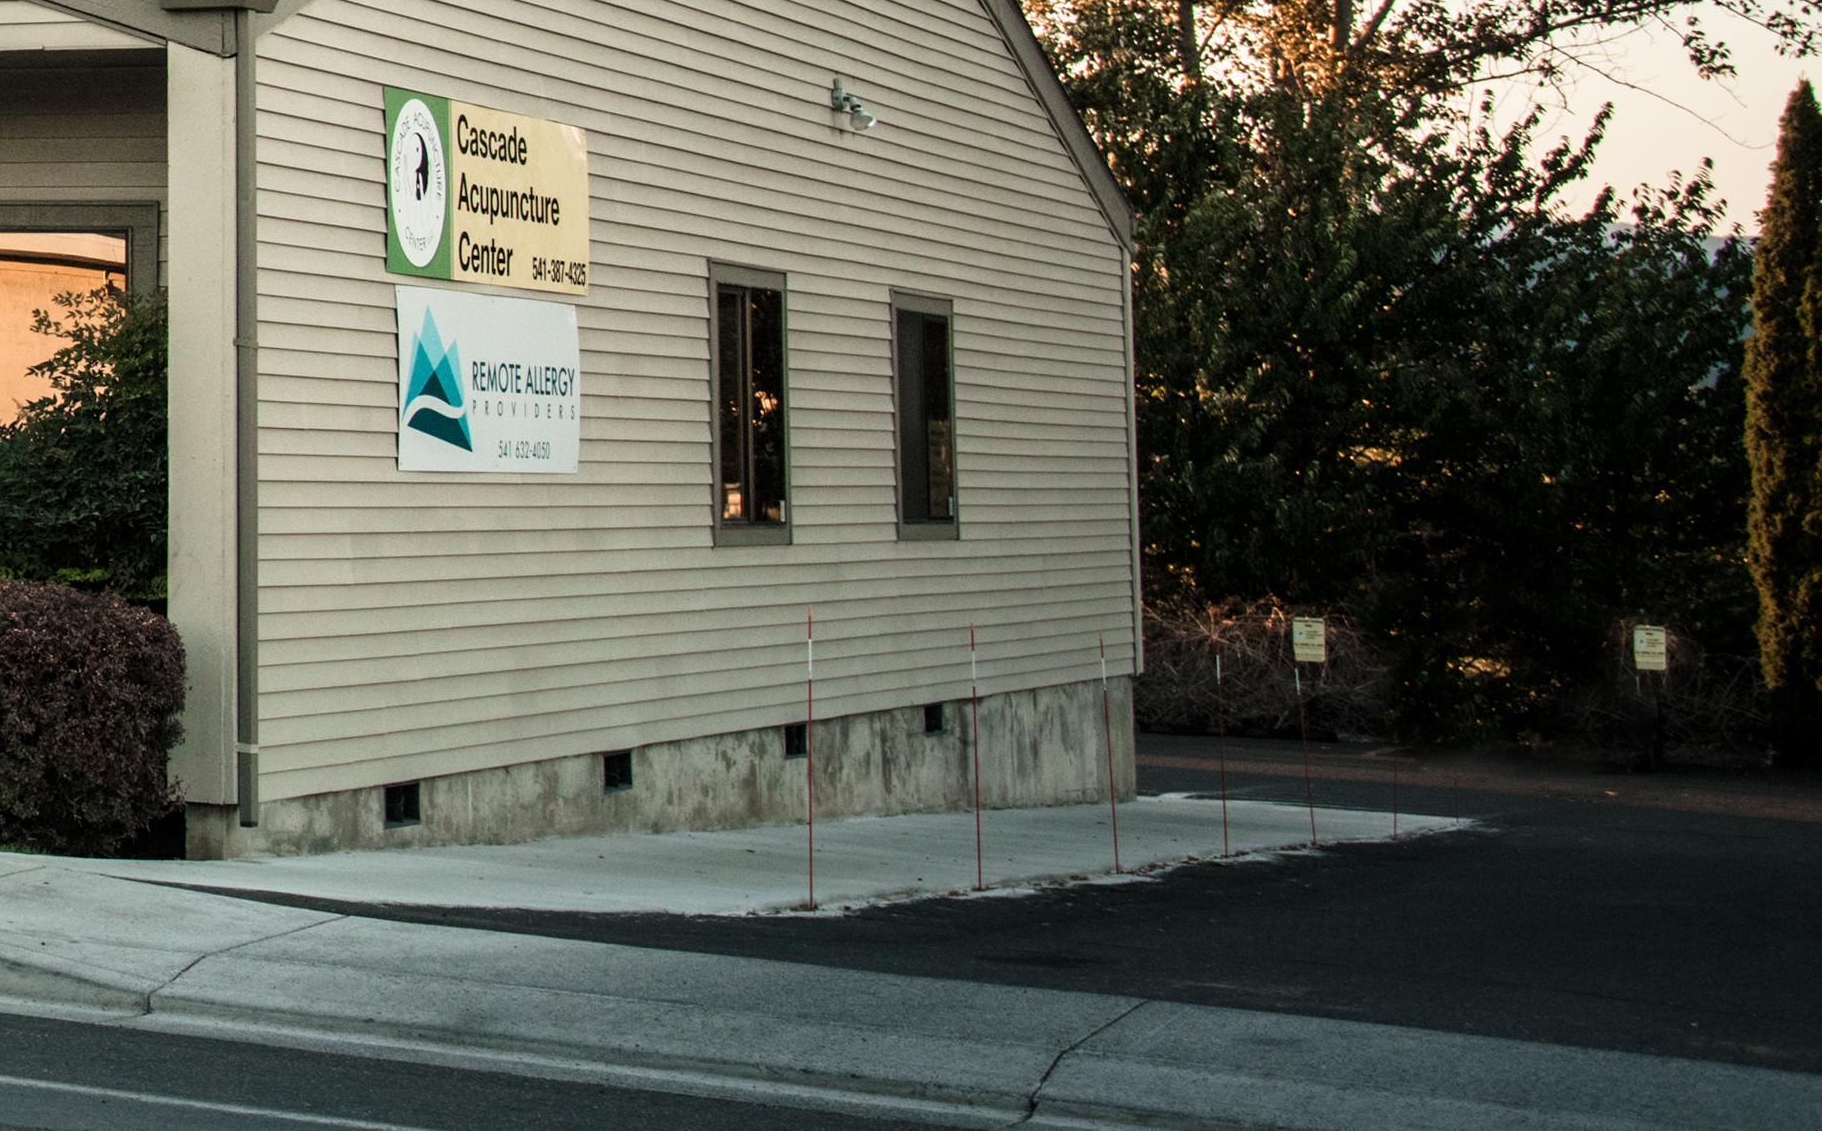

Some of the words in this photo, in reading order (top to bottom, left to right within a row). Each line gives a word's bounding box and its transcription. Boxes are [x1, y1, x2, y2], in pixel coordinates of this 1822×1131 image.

[394, 115, 411, 193] CASCADE
[413, 112, 442, 202] ACUPUNCTURE
[457, 114, 528, 166] Cascade
[458, 172, 560, 226] Acupuncture
[405, 225, 427, 252] CENTER
[458, 231, 513, 277] Center
[532, 256, 587, 287] 541-387-4325
[472, 360, 521, 394] REMOTE
[525, 364, 575, 397] ALLERGY
[472, 399, 575, 420] PROVIDERS
[498, 440, 512, 458] 541
[515, 441, 551, 459] 632-4050
